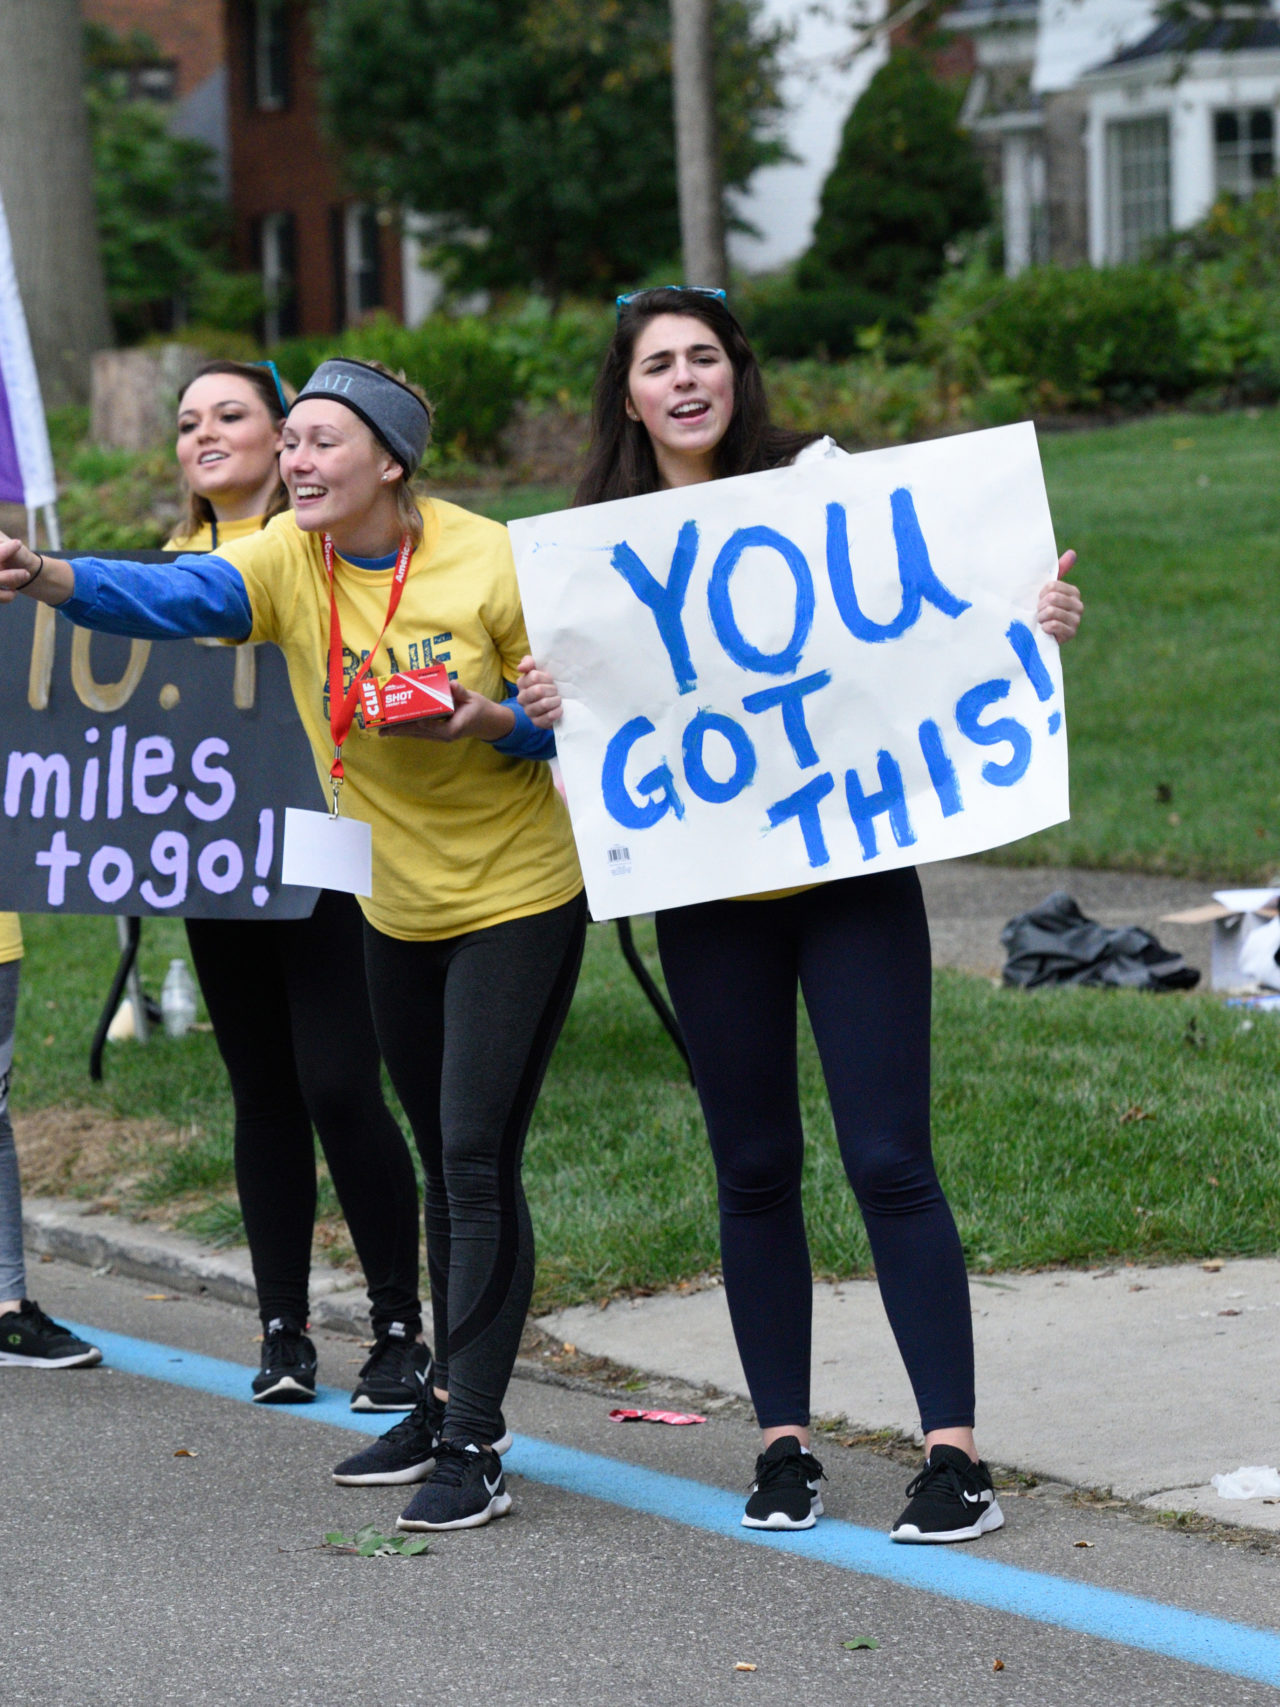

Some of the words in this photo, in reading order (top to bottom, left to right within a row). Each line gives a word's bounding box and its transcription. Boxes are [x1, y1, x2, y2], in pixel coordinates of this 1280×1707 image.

[395, 535, 412, 583] Americ
[609, 486, 972, 696] YOU
[362, 682, 380, 716] CLIF
[385, 690, 414, 705] SHOT
[763, 618, 1062, 869] THIS!
[4, 725, 237, 821] miles
[601, 669, 832, 830] GOT
